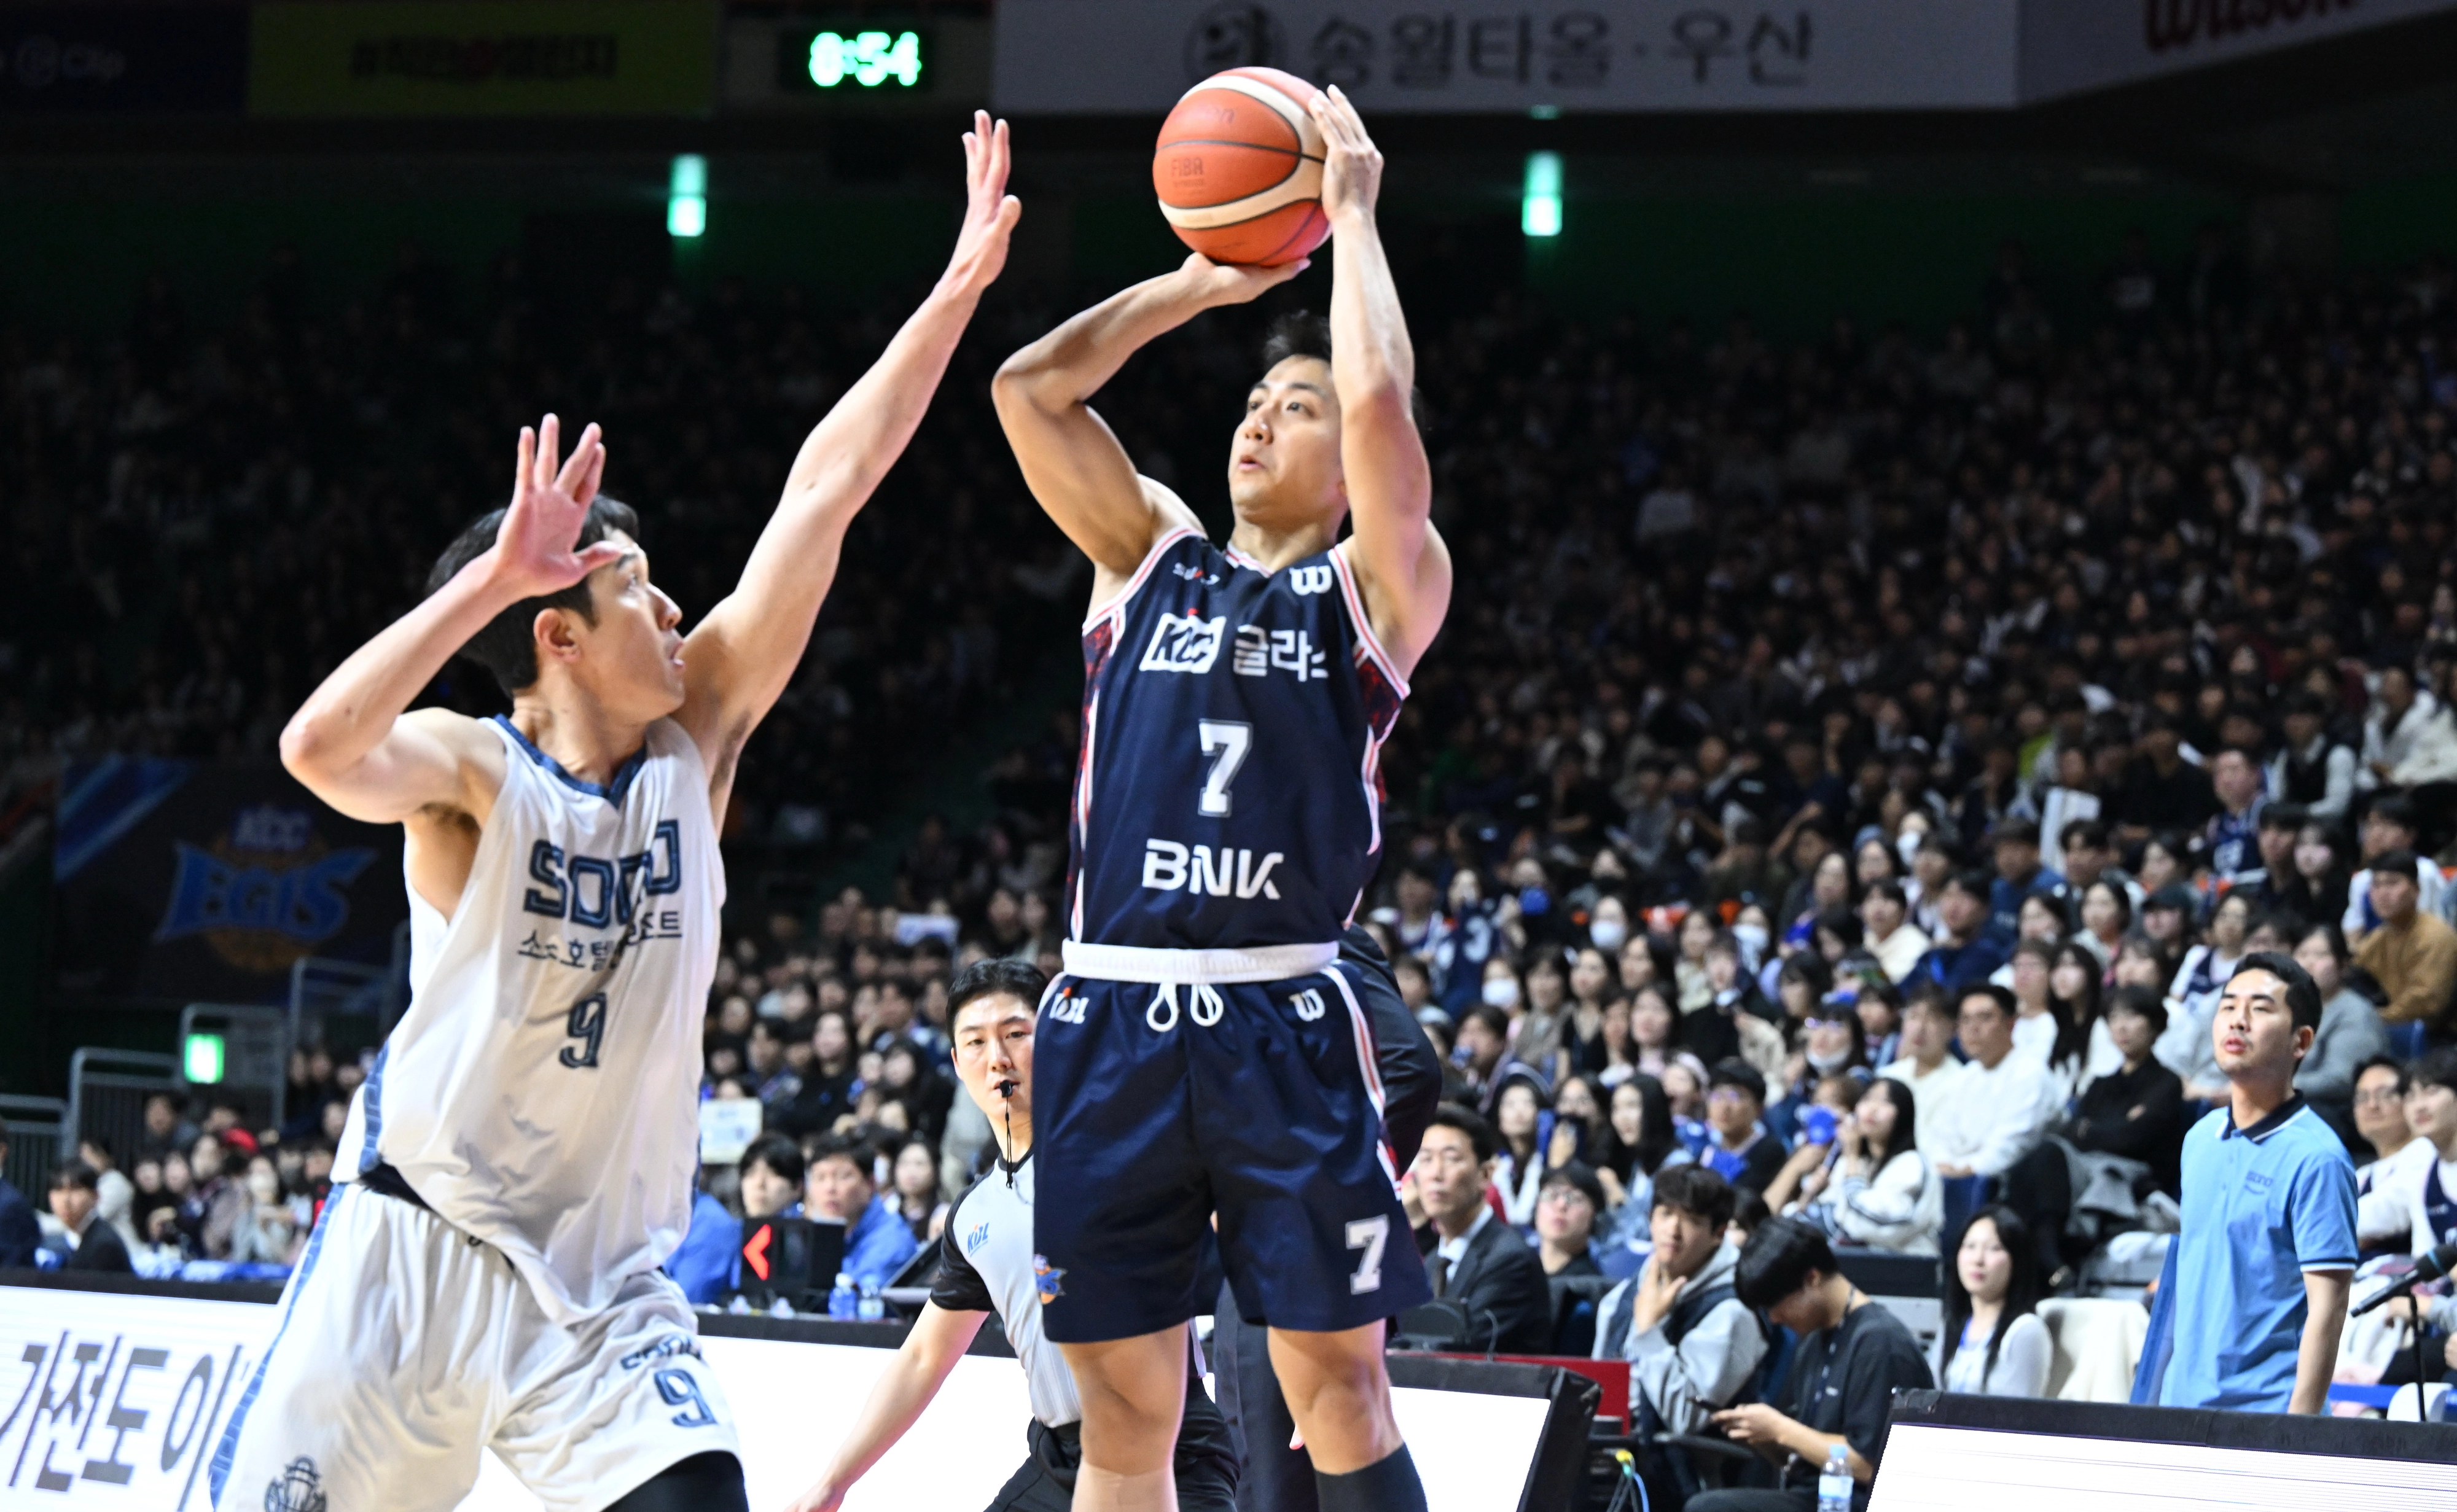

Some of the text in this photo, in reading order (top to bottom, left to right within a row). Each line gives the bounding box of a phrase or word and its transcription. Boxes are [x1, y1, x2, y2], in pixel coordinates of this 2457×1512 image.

[1170, 157, 1203, 177] FIBA
[1198, 718, 1252, 817] 7
[152, 839, 379, 946] EGIS
[1142, 838, 1284, 900] BNK
[559, 991, 607, 1069] 9
[1345, 1214, 1389, 1295] 7
[654, 1369, 719, 1428] 9
